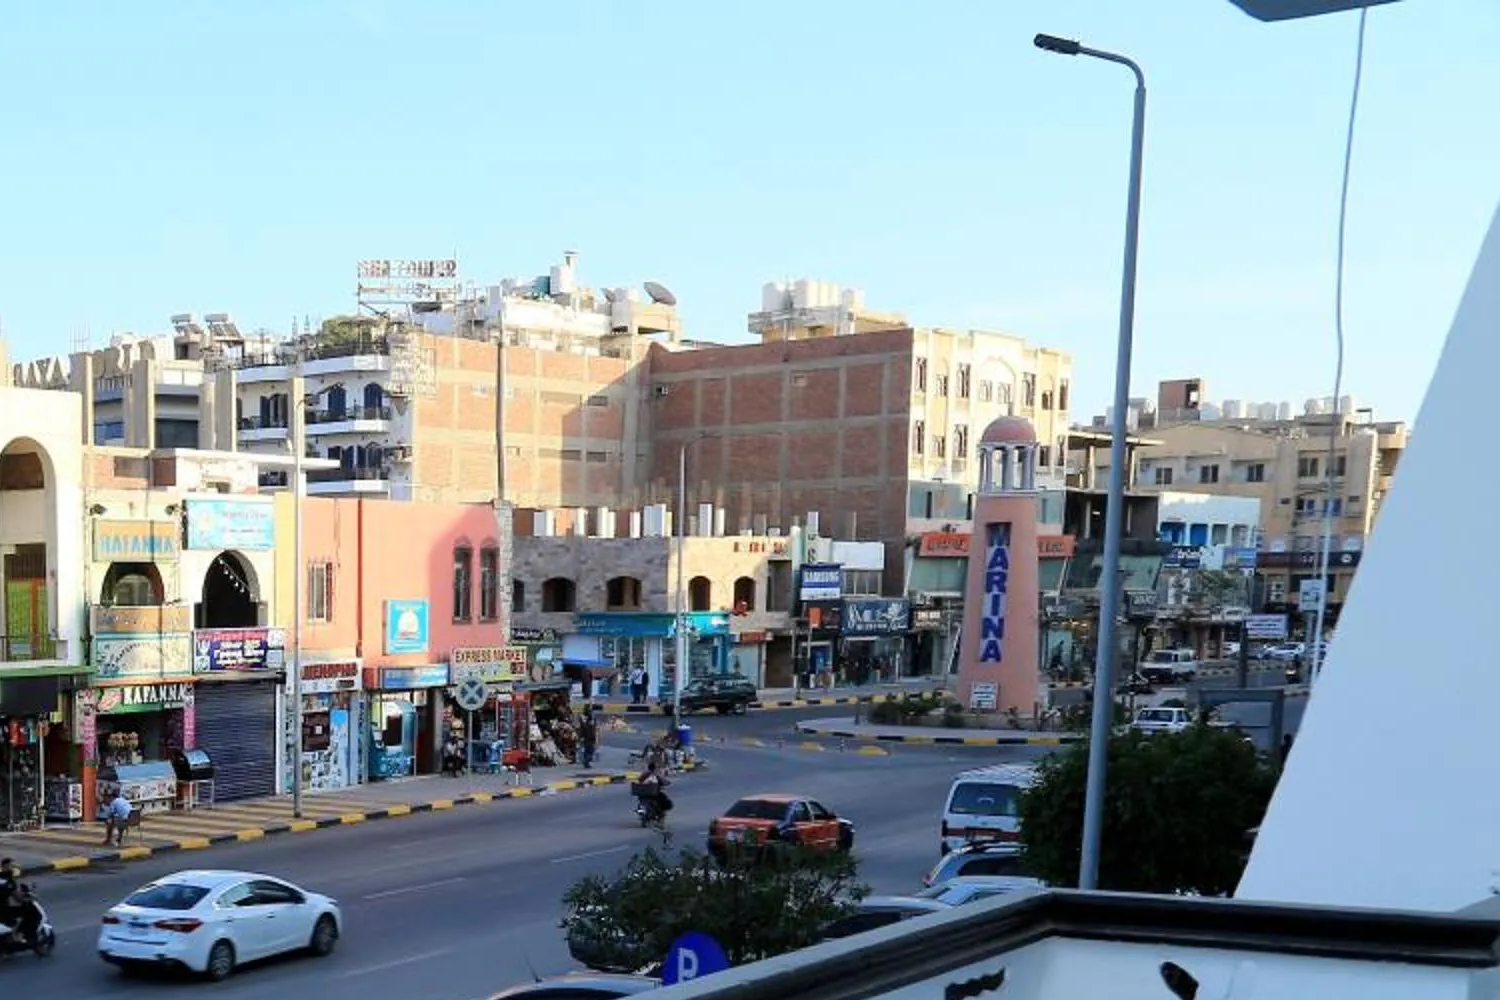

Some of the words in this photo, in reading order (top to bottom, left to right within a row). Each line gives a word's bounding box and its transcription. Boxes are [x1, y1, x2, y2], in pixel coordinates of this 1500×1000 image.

[980, 523, 1010, 662] MARINA
[455, 650, 491, 662] EXPRESS
[493, 649, 525, 661] MARKET
[678, 947, 698, 984] P
